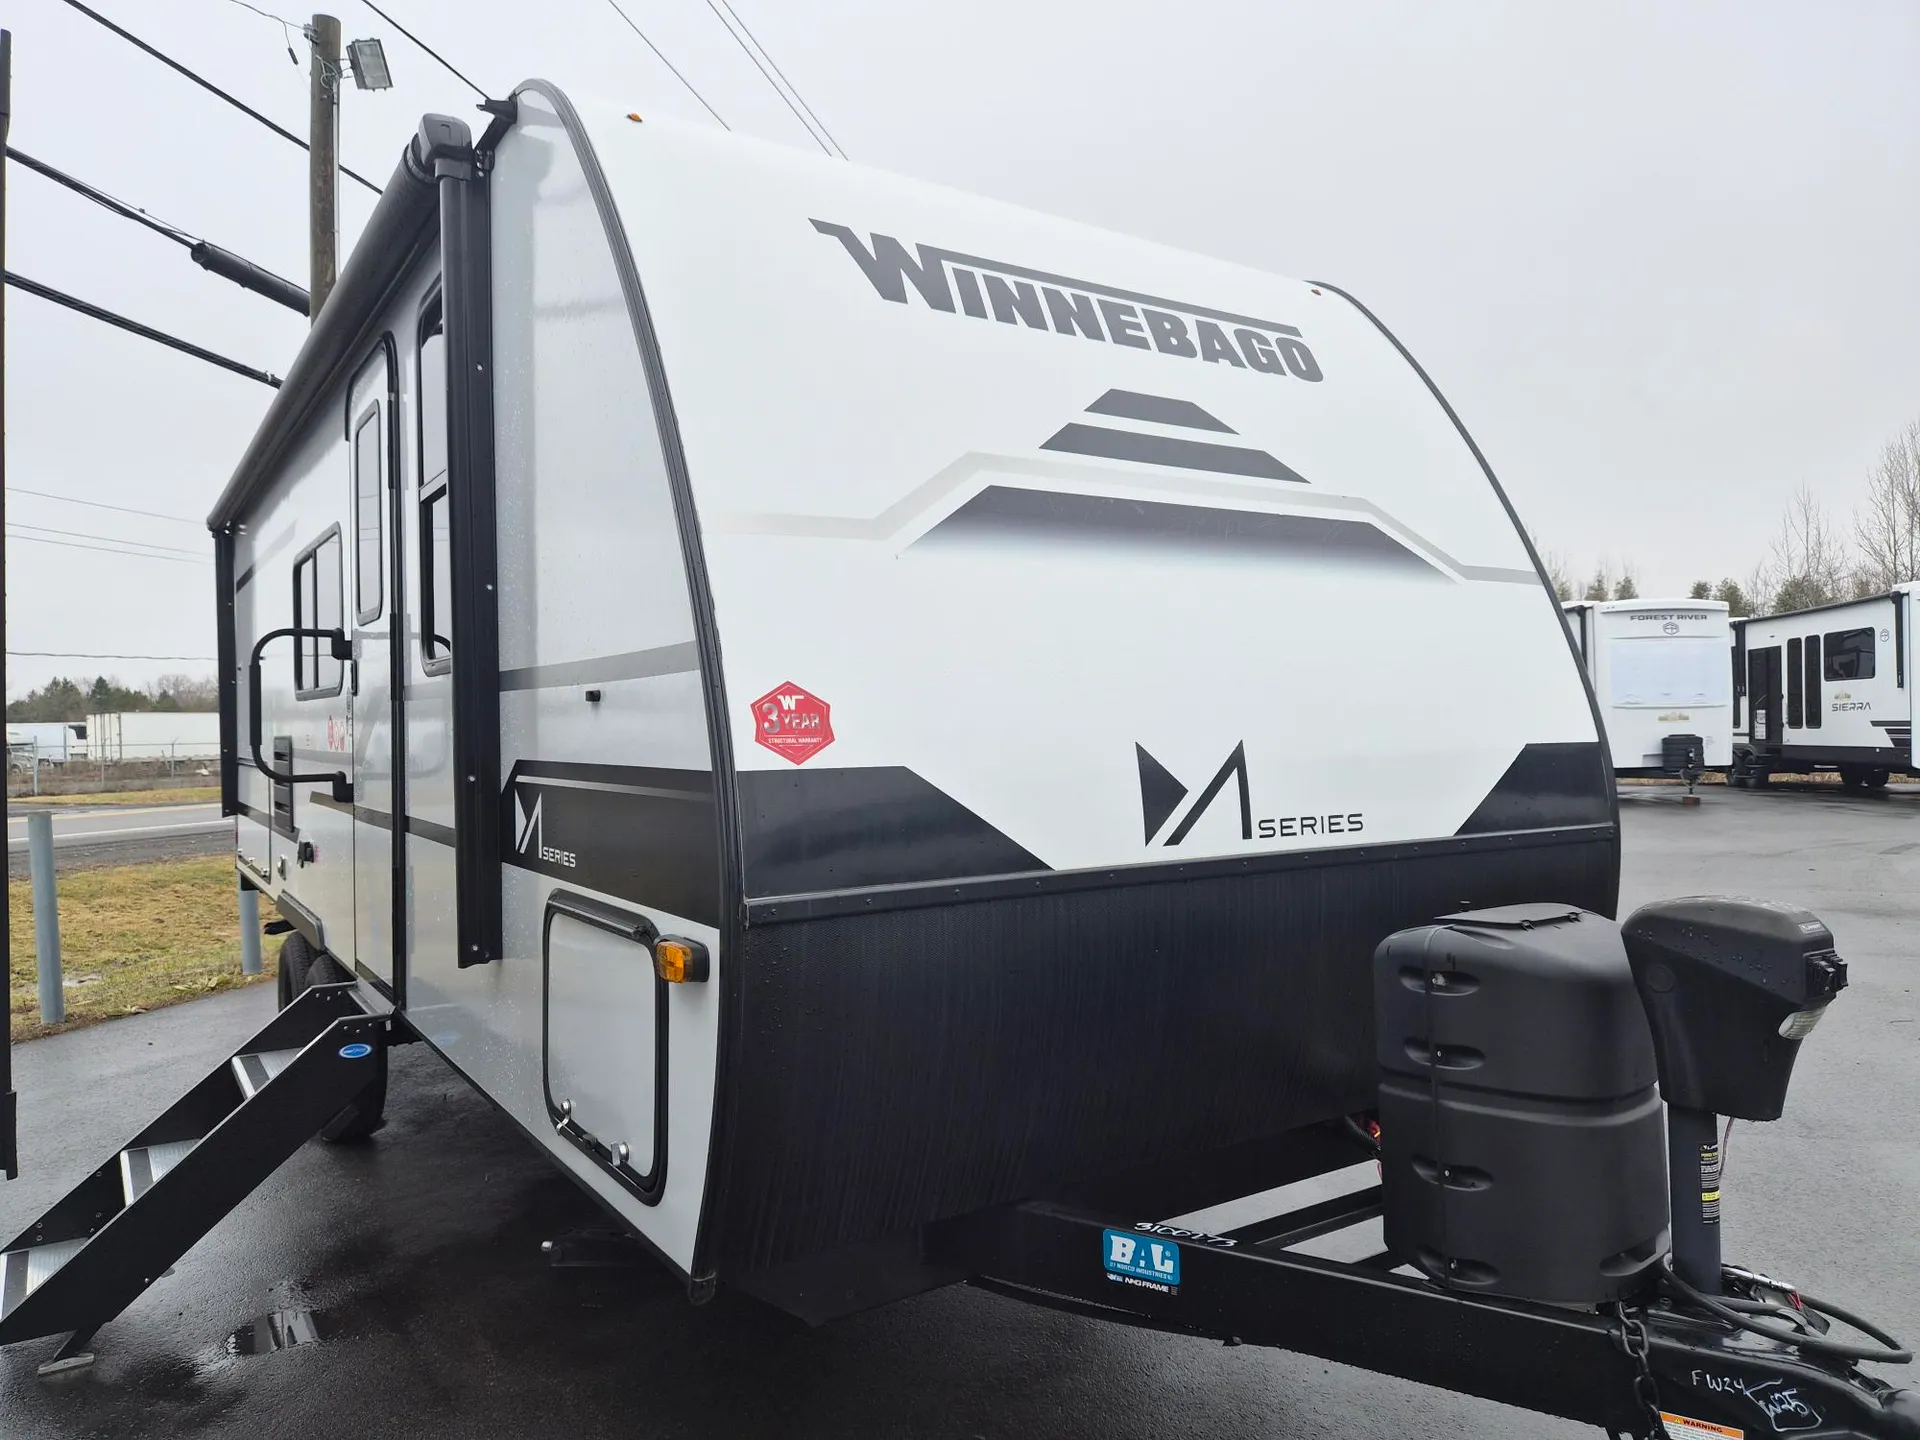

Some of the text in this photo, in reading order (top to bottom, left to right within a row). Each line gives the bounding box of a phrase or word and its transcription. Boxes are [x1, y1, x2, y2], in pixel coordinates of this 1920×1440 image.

[807, 217, 1324, 382] WINNEBAGO
[763, 703, 820, 733] 3 YEAR
[1831, 702, 1871, 711] SIERRA
[1258, 813, 1363, 838] SERIES
[542, 846, 576, 868] SERIES
[1110, 1235, 1174, 1273] BAL
[1142, 1281, 1169, 1292] FRAME
[1682, 1419, 1723, 1433] WARNING
